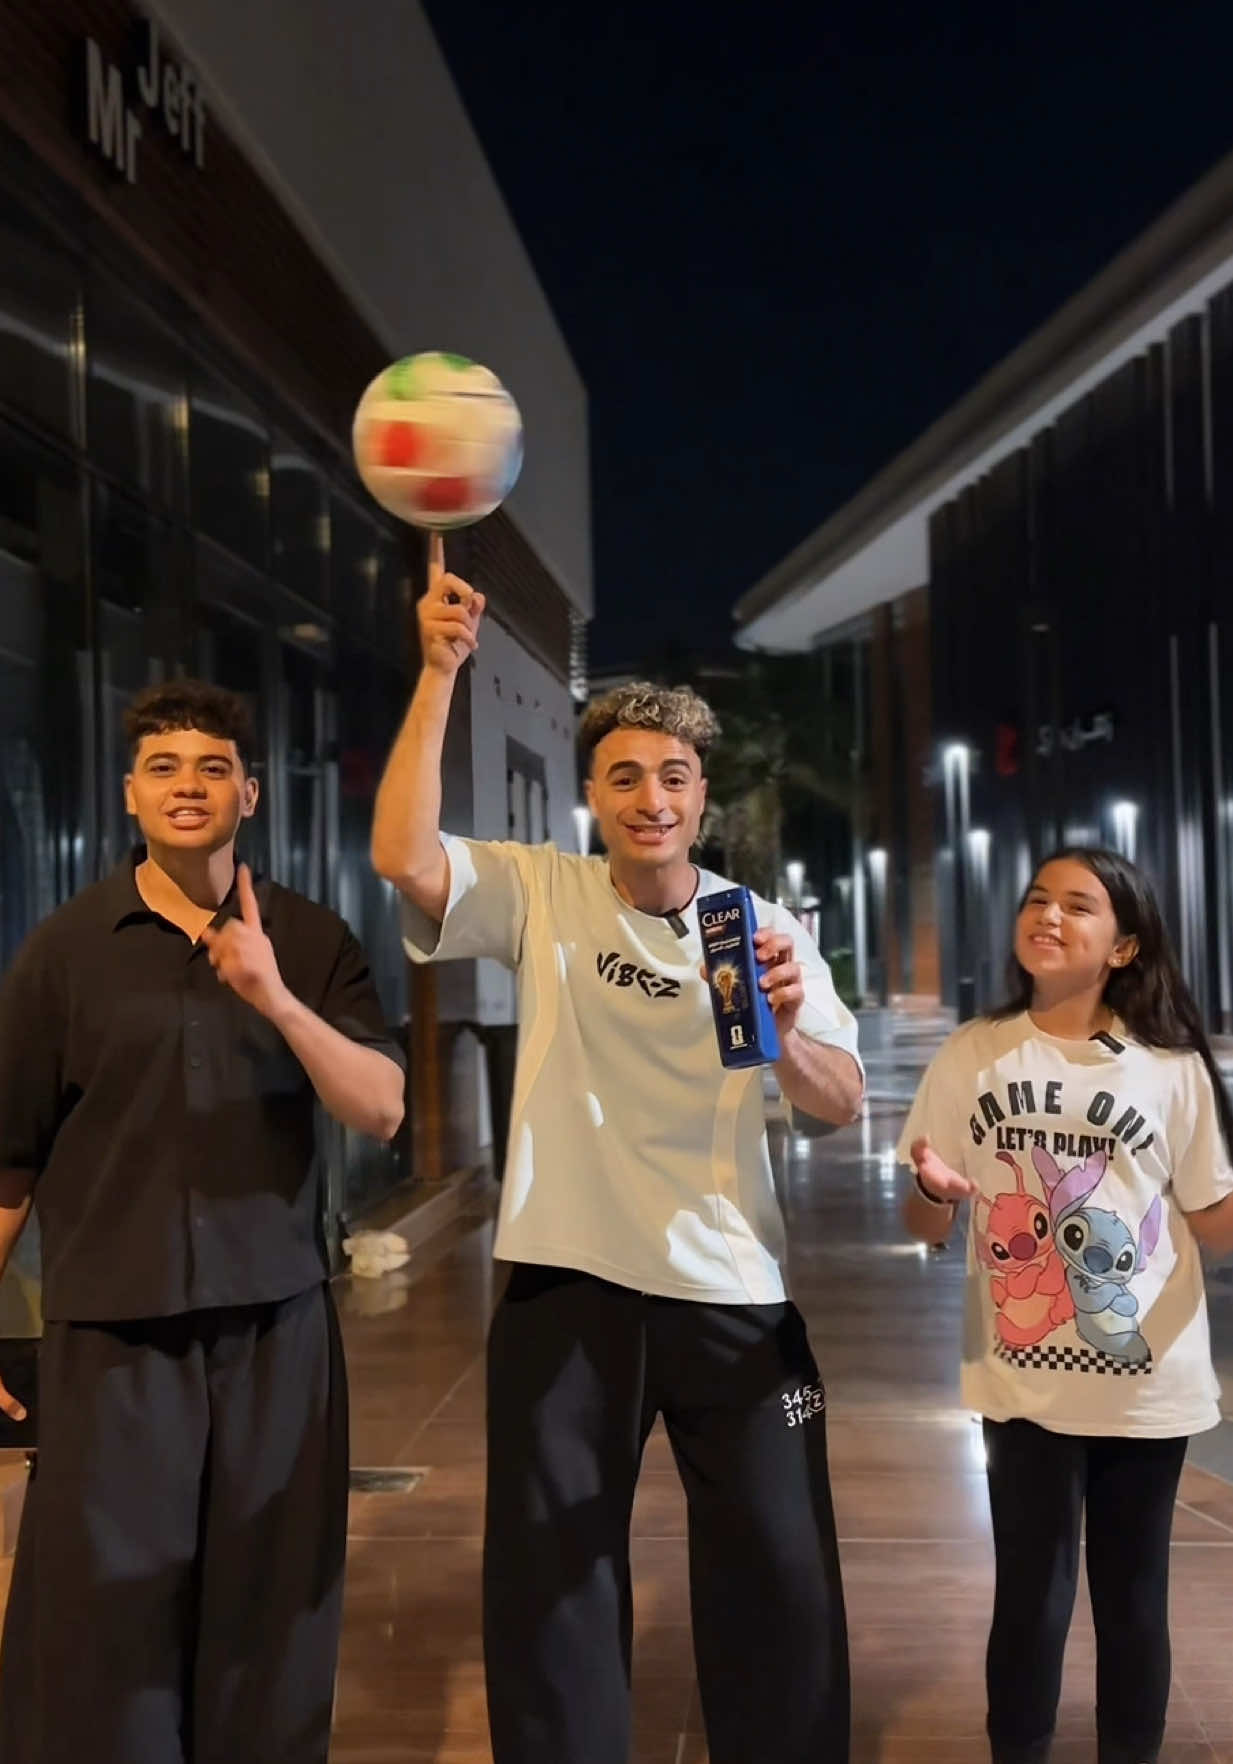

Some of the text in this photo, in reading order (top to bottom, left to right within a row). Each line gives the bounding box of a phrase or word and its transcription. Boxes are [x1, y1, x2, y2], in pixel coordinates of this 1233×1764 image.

[86, 37, 142, 183] Mr
[136, 20, 206, 169] Jeff
[702, 908, 741, 928] CLEAR
[969, 1080, 1063, 1146] GAME
